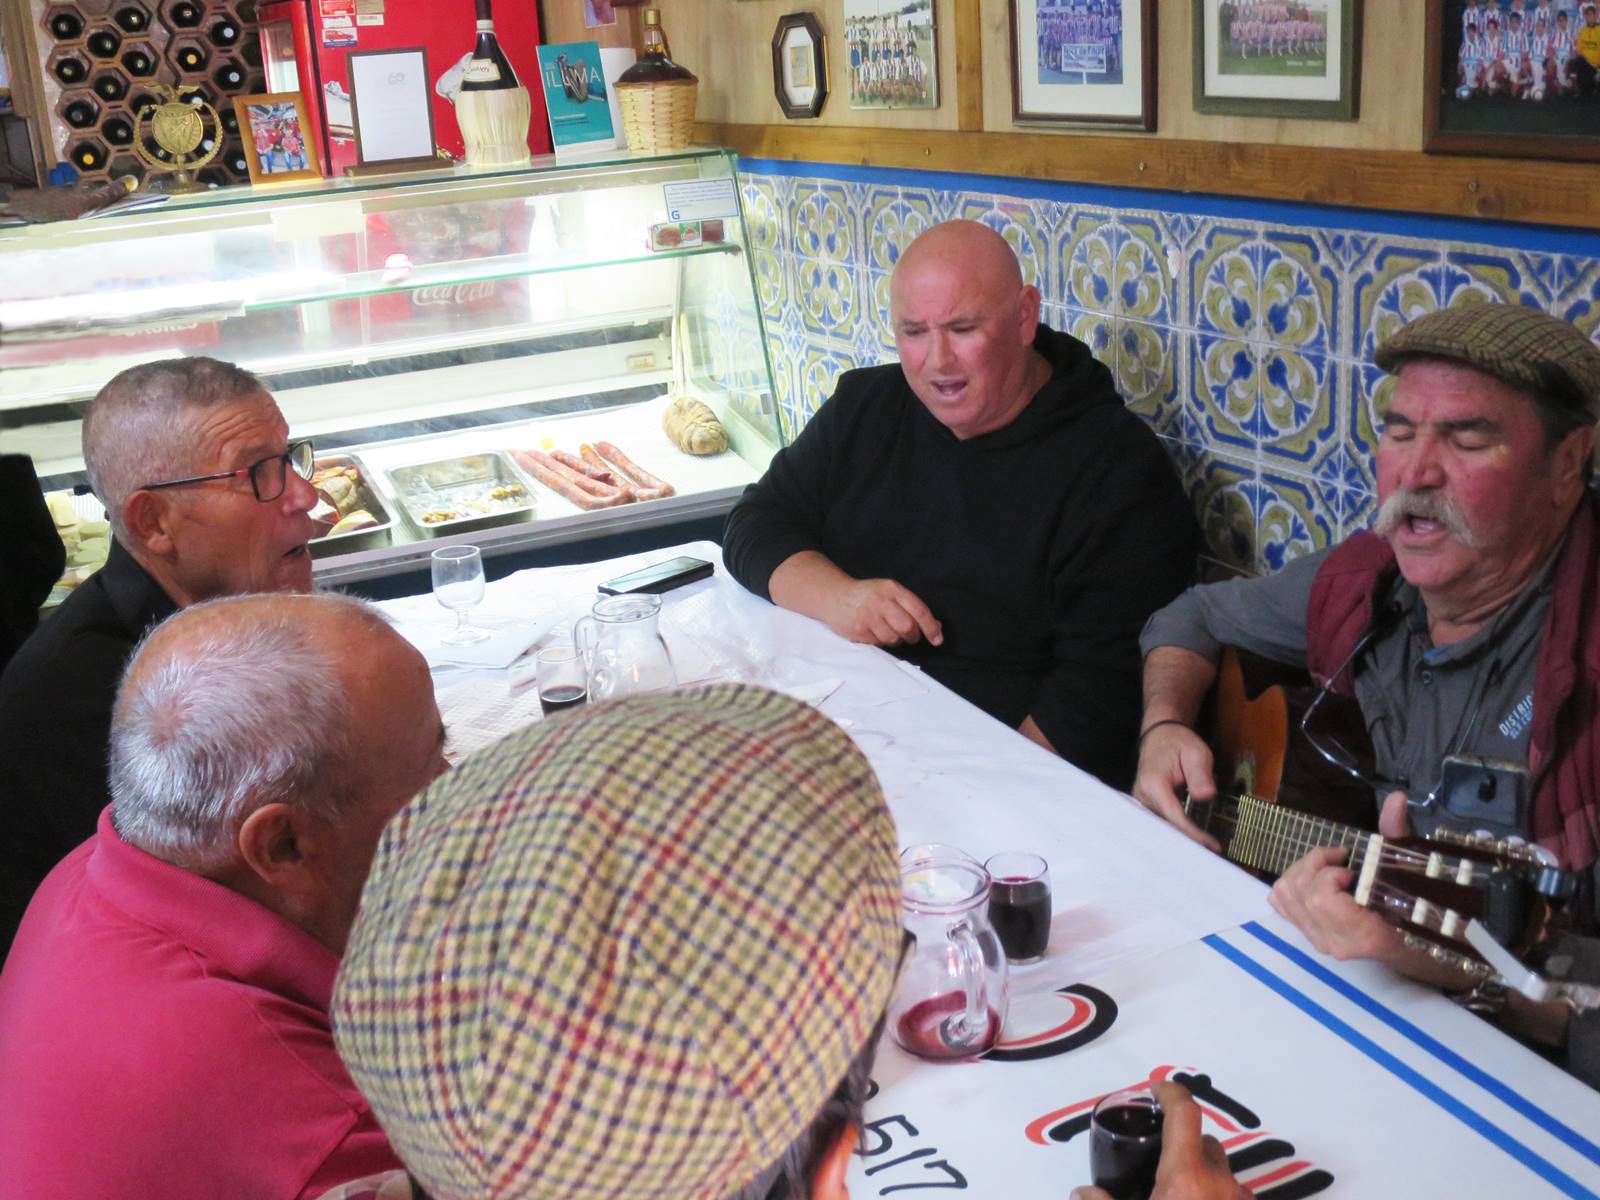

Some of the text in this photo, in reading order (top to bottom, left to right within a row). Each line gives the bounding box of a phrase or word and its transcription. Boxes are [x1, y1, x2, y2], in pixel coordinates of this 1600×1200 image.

[545, 67, 602, 88] ILUMA
[671, 210, 680, 220] G
[1499, 692, 1534, 737] DISTRIC
